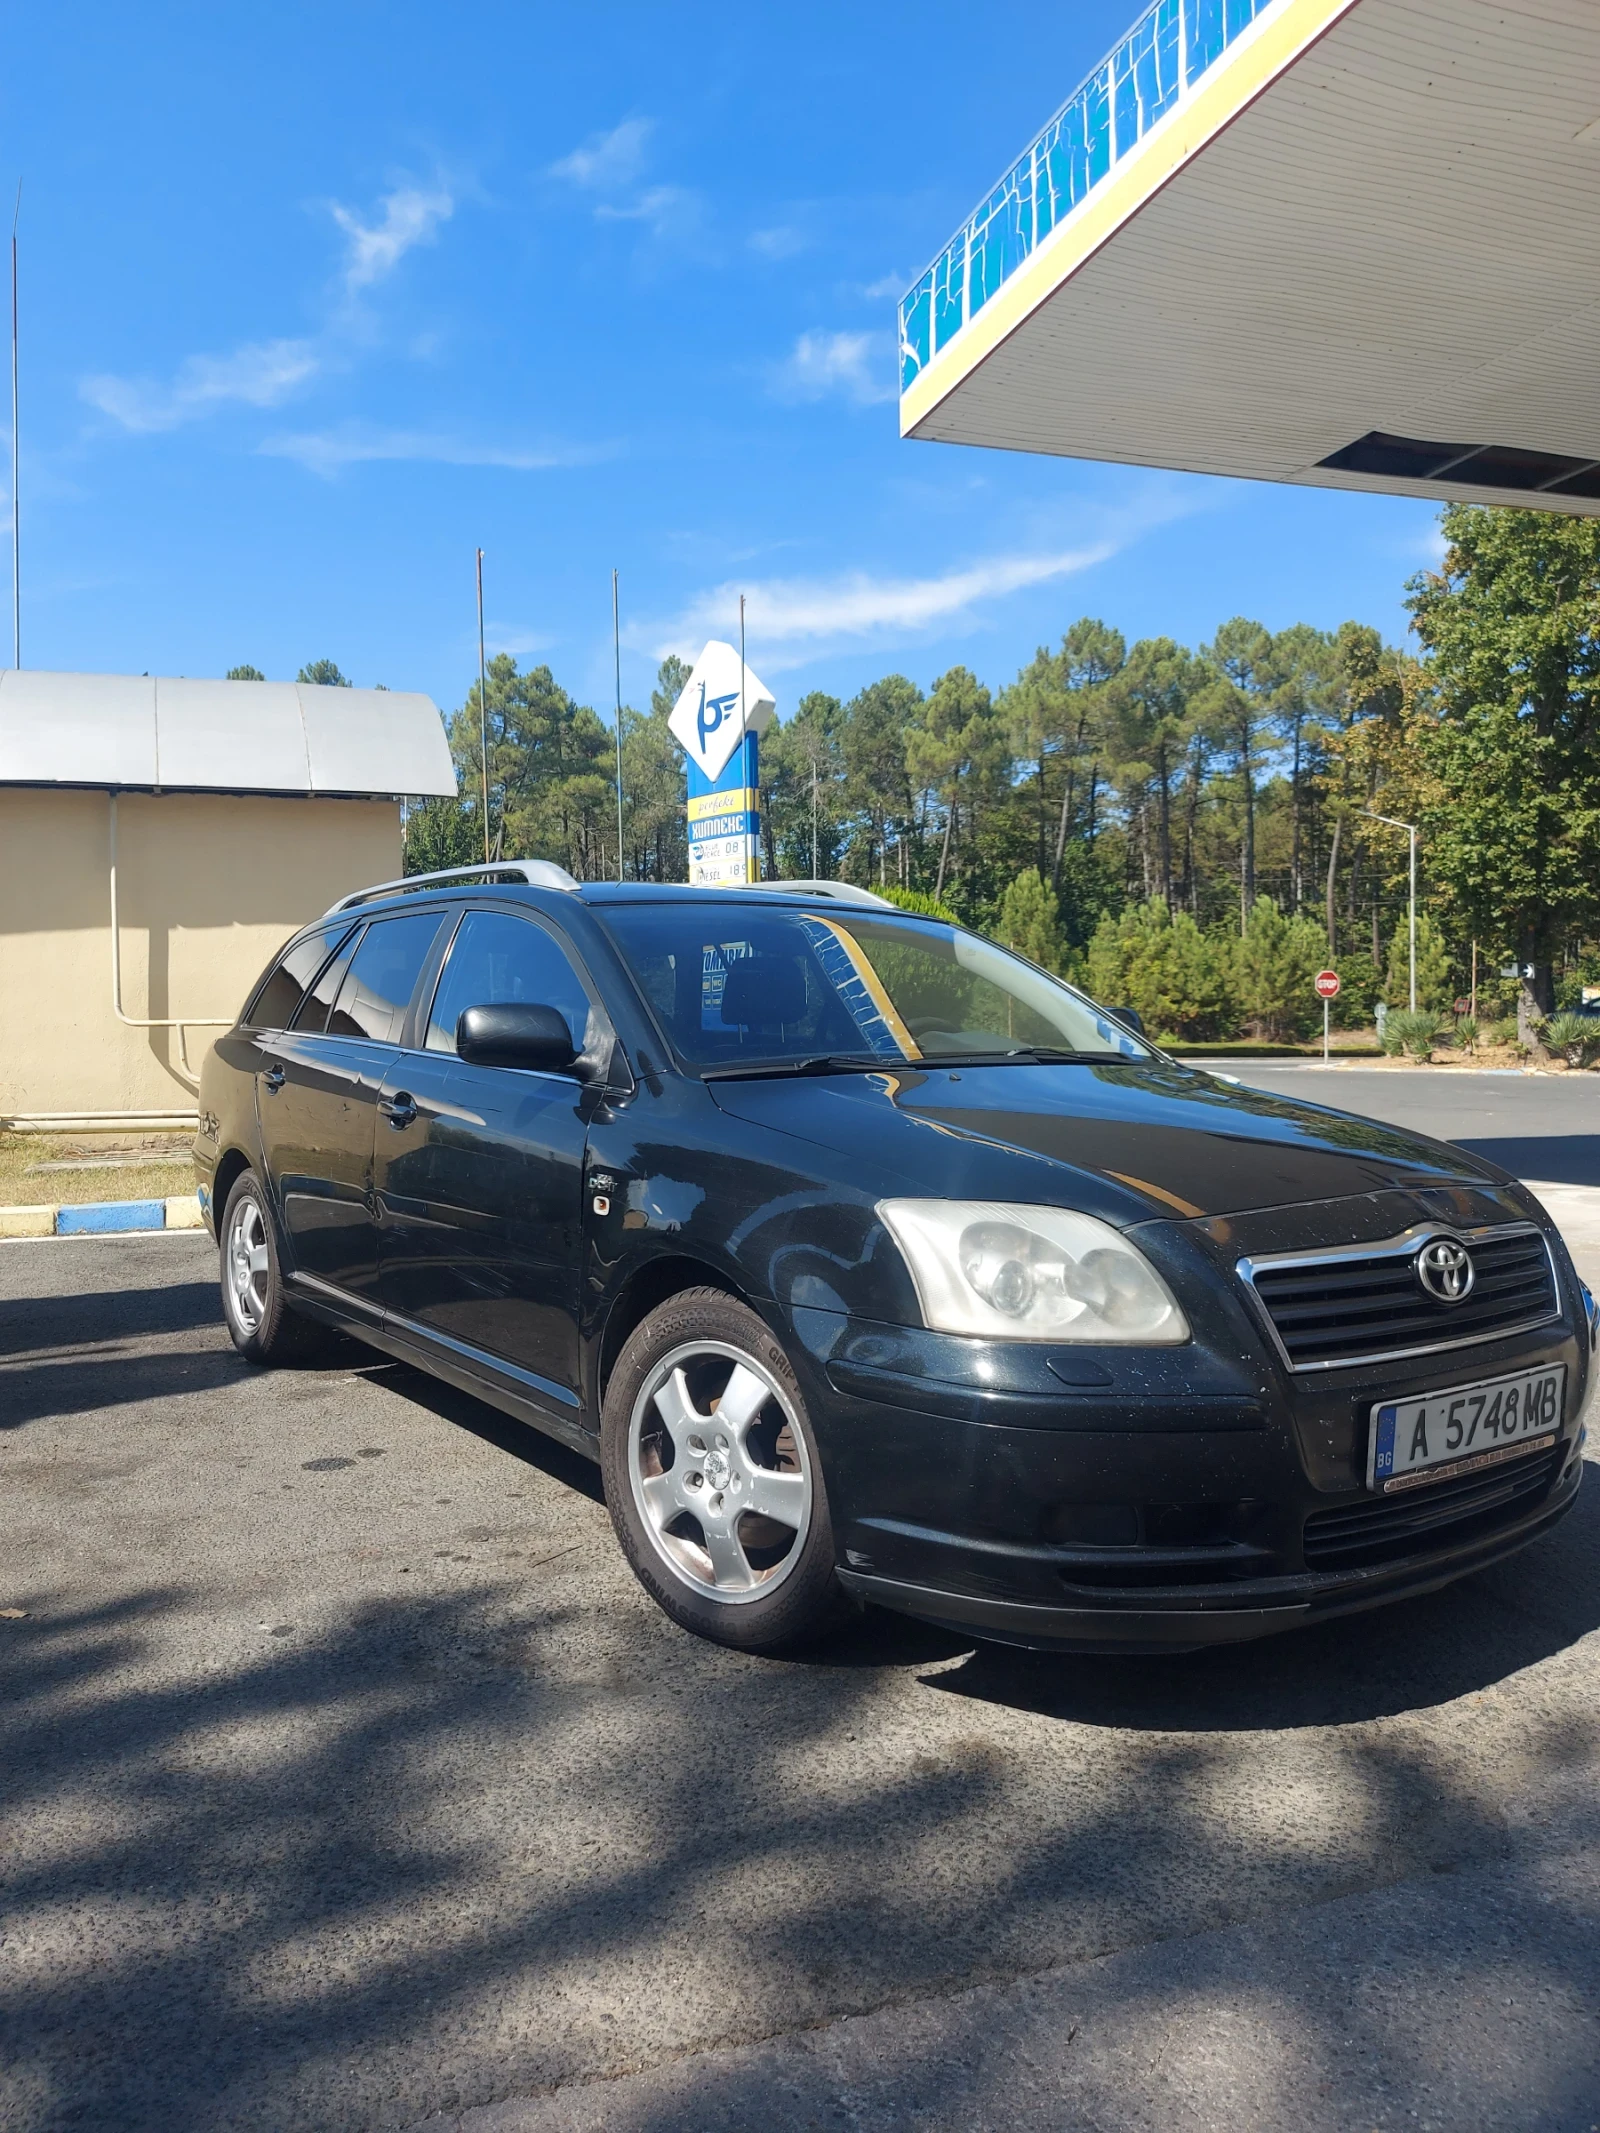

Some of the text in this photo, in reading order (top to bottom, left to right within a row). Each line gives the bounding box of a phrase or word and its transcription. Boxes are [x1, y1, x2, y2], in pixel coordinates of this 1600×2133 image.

[768, 1346, 796, 1381] GRIP
[1409, 1408, 1429, 1461] A
[1446, 1387, 1520, 1450] 5748
[1377, 1451, 1392, 1469] BG
